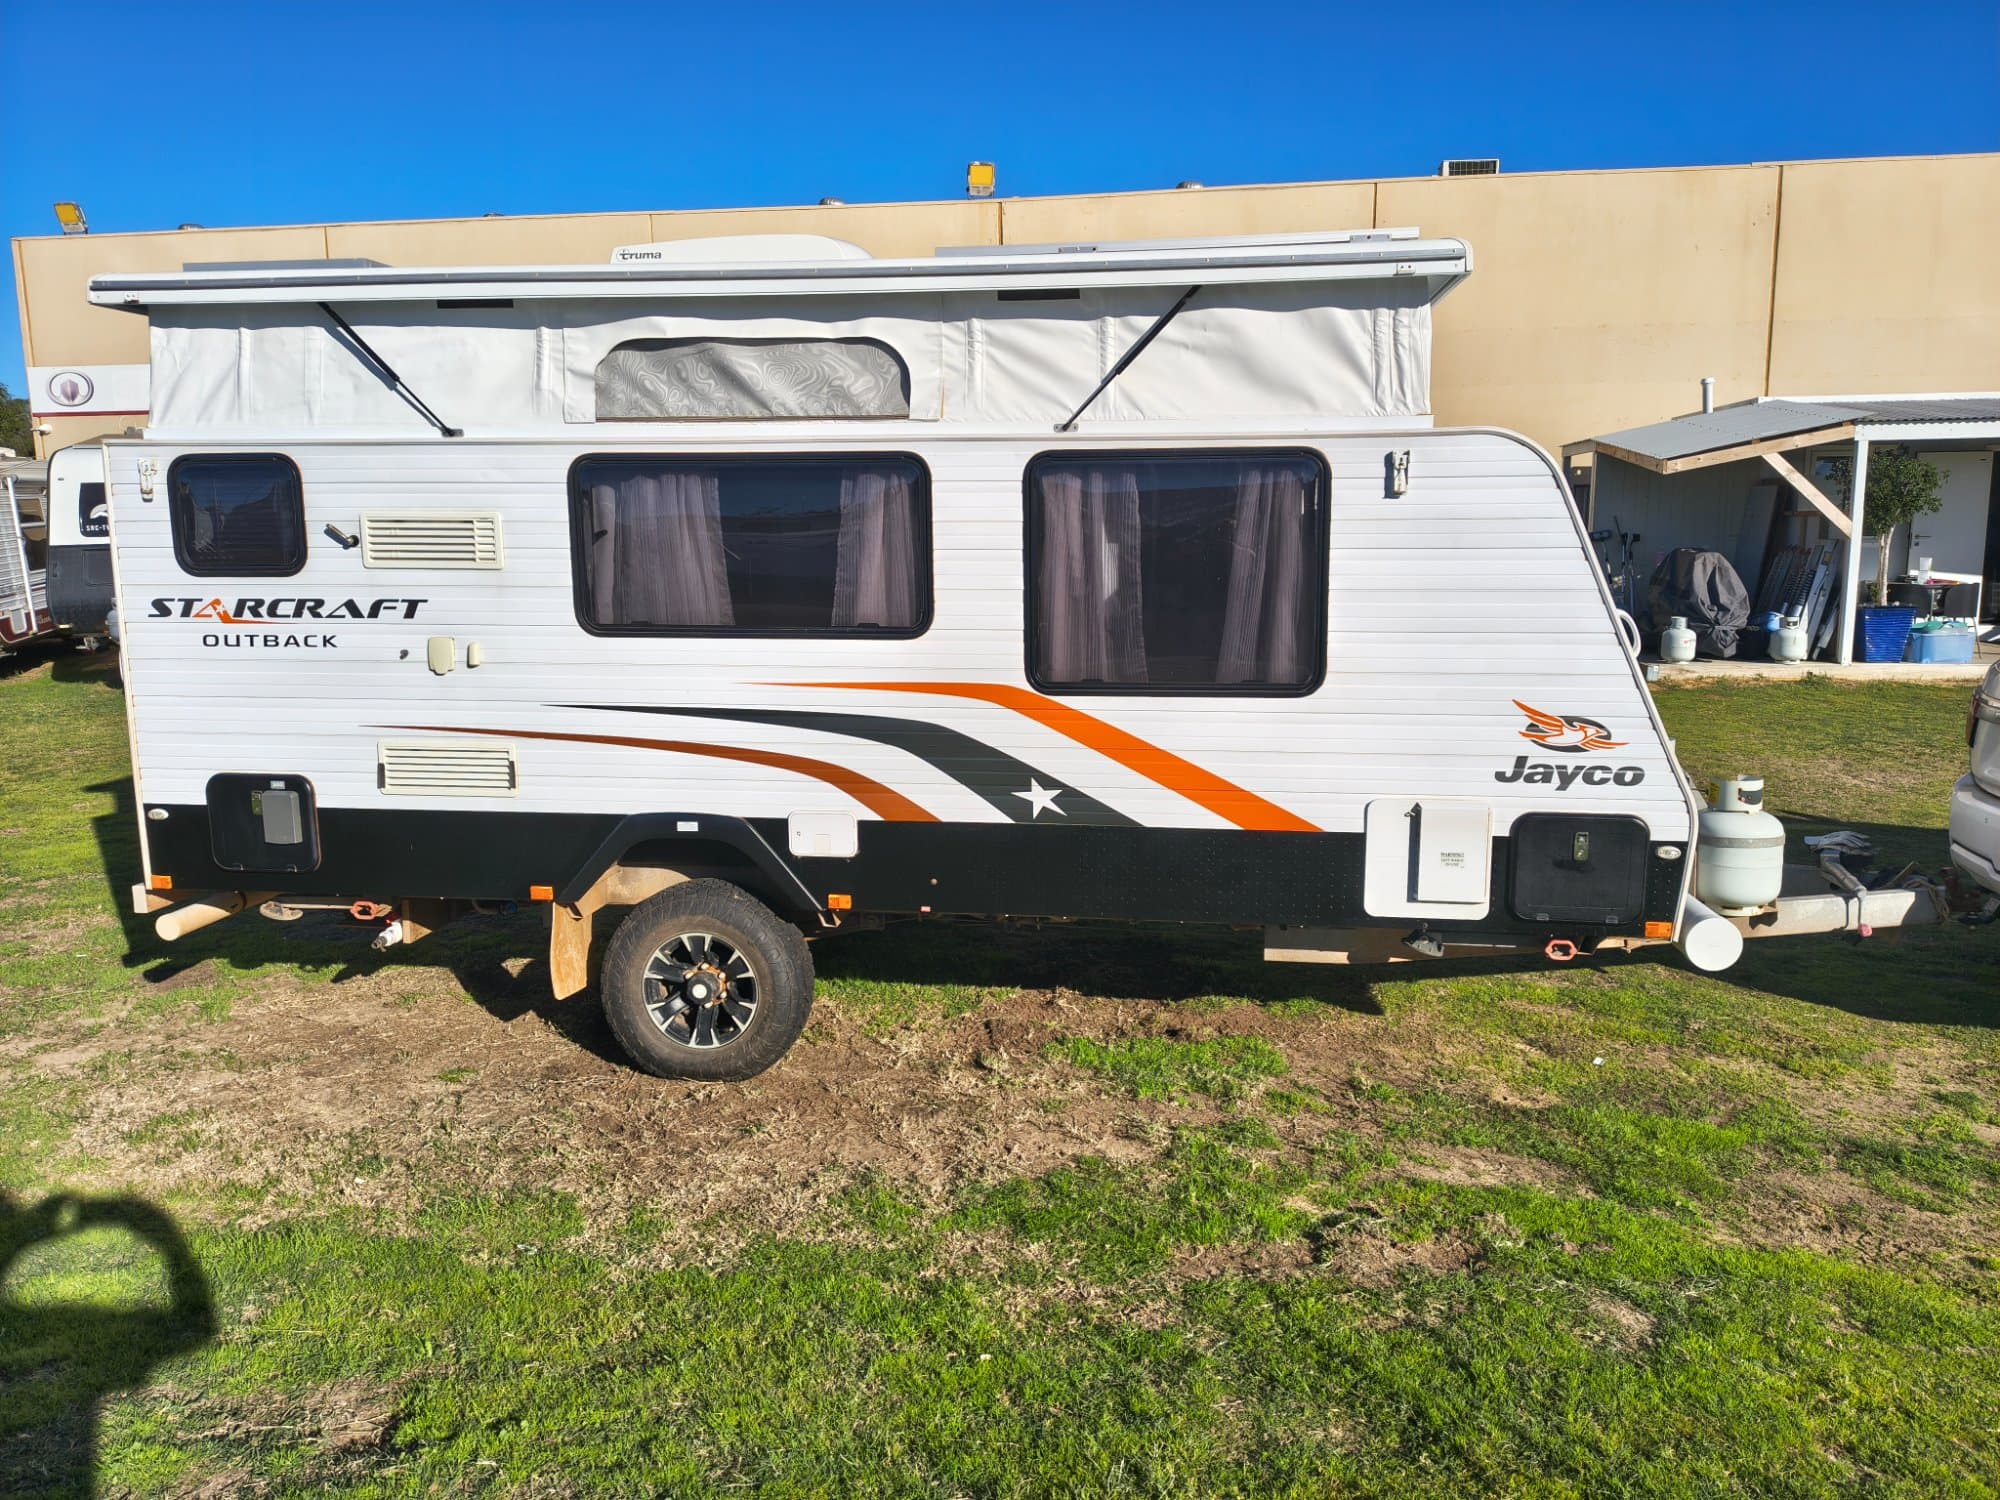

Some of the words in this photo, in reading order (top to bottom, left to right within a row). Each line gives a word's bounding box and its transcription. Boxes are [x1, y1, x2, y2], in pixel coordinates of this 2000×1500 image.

[618, 249, 662, 260] truma
[148, 598, 428, 624] STARCRAFT
[202, 634, 338, 648] OUTBACK
[1494, 755, 1645, 791] Jayco
